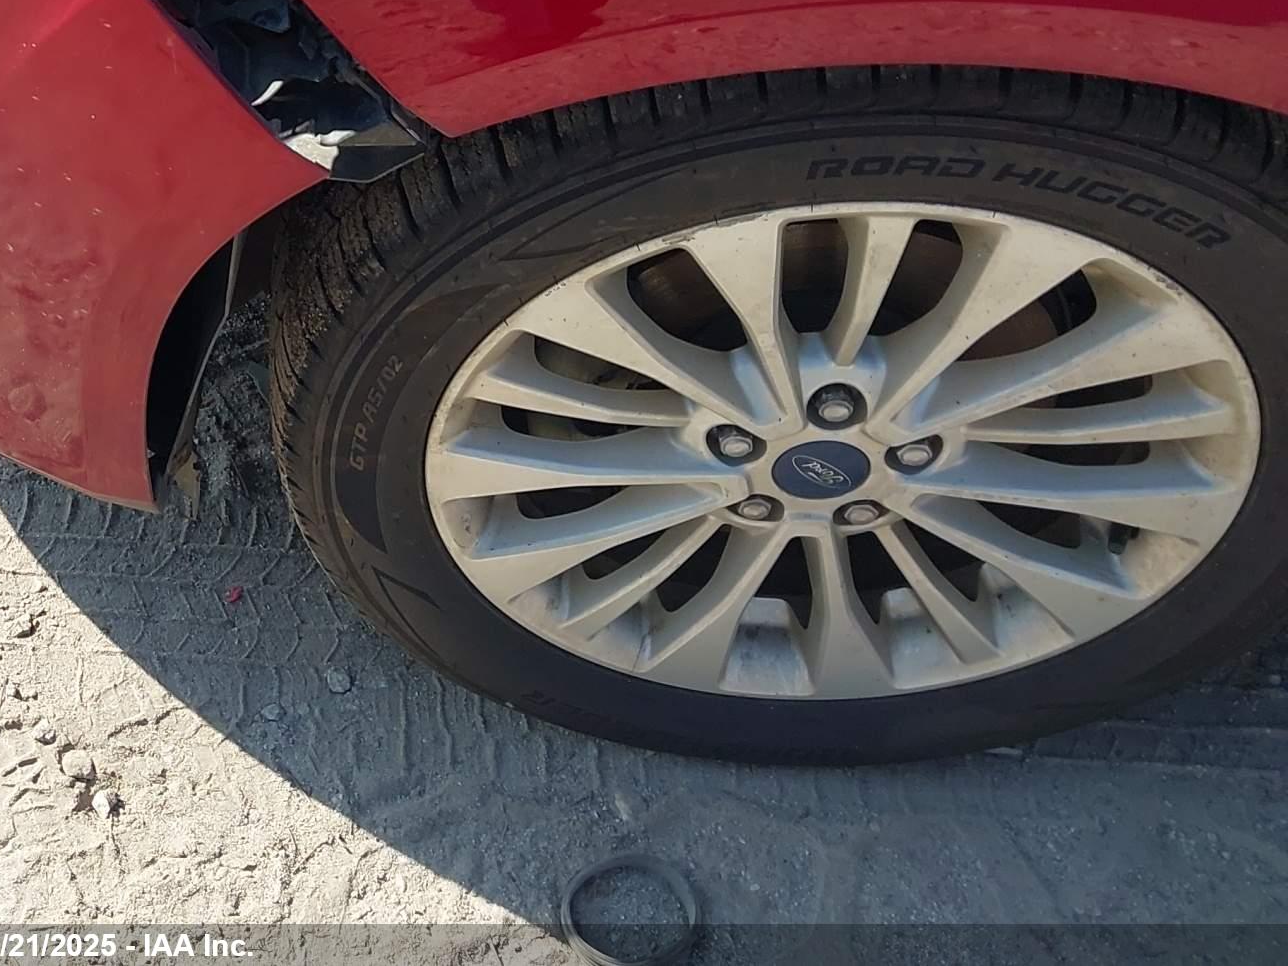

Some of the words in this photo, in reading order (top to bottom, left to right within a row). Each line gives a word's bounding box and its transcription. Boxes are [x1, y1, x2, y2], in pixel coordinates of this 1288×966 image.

[806, 155, 986, 181] ROAD
[992, 162, 1232, 249] HUGGER
[800, 461, 844, 485] Ford
